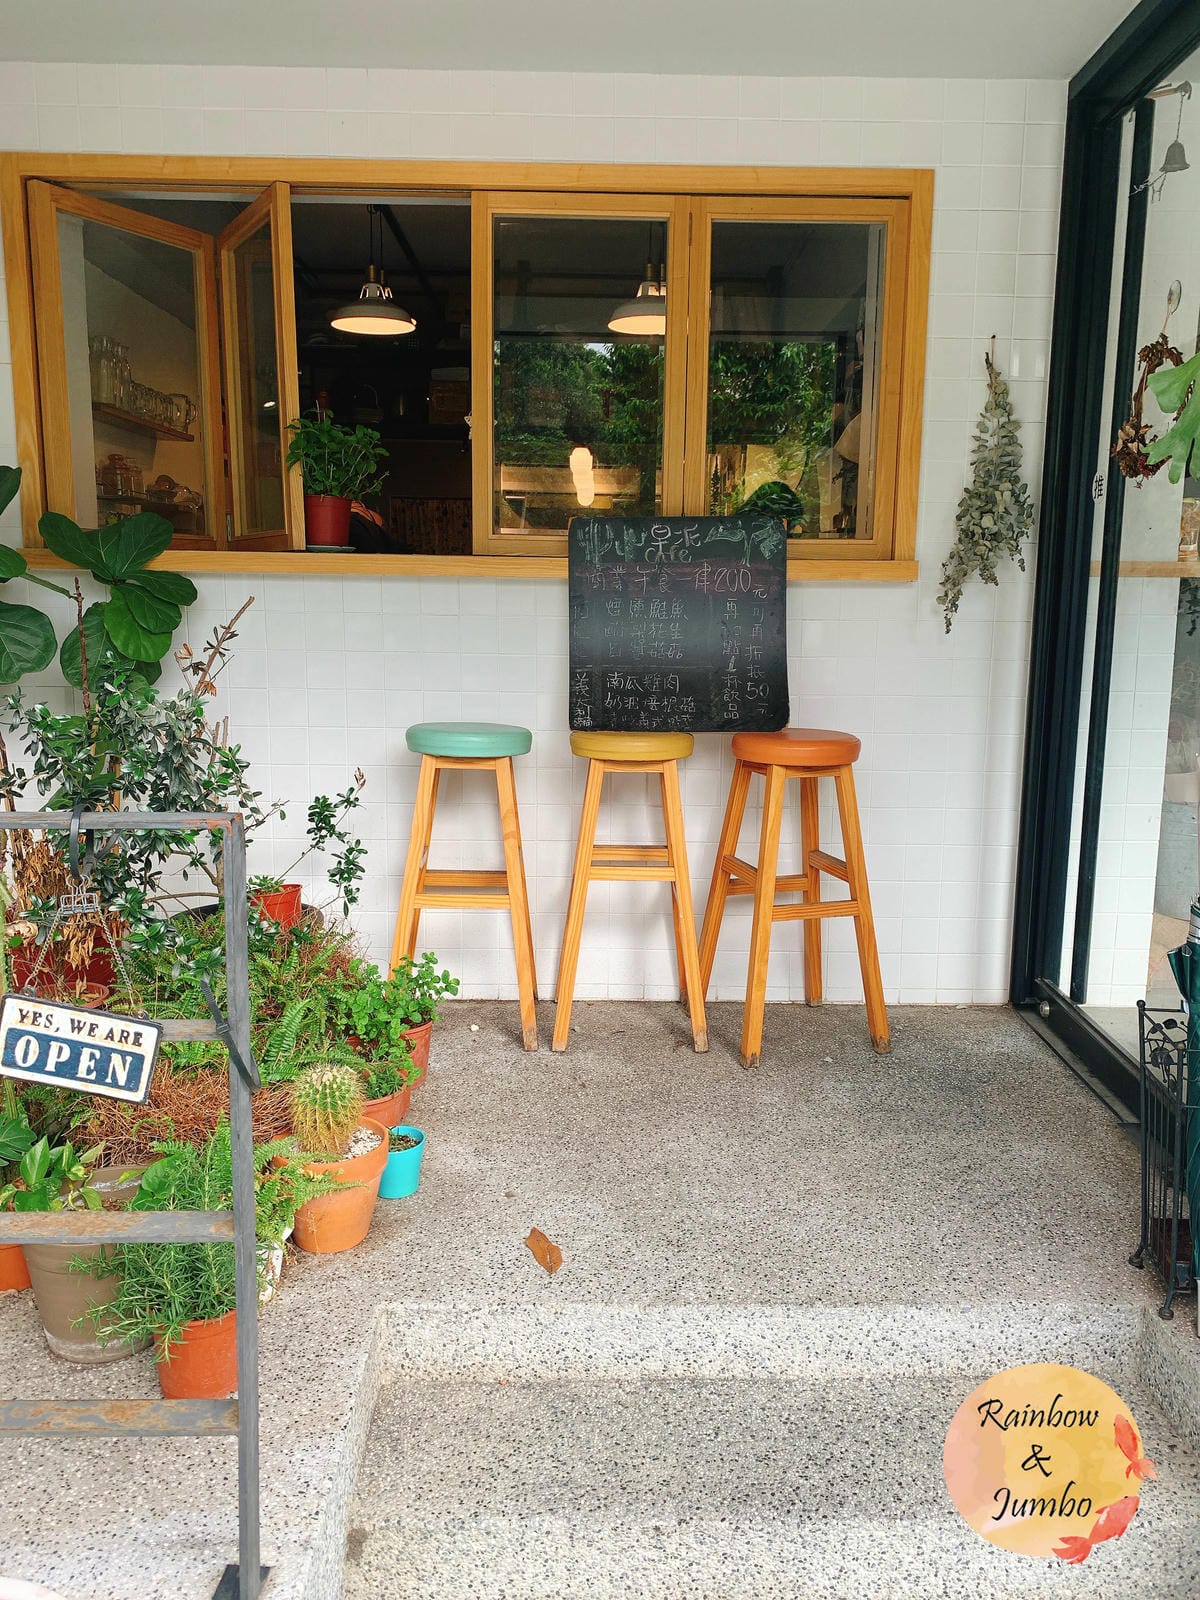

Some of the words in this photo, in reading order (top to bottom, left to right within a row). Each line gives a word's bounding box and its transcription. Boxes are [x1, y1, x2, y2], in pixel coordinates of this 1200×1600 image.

[1094, 475, 1104, 499] 推
[606, 672, 680, 693] 南瓜雞肉
[18, 1008, 60, 1033] YES,
[70, 1018, 99, 1038] WE
[104, 1027, 144, 1047] ARE
[15, 1035, 133, 1086] OPEN
